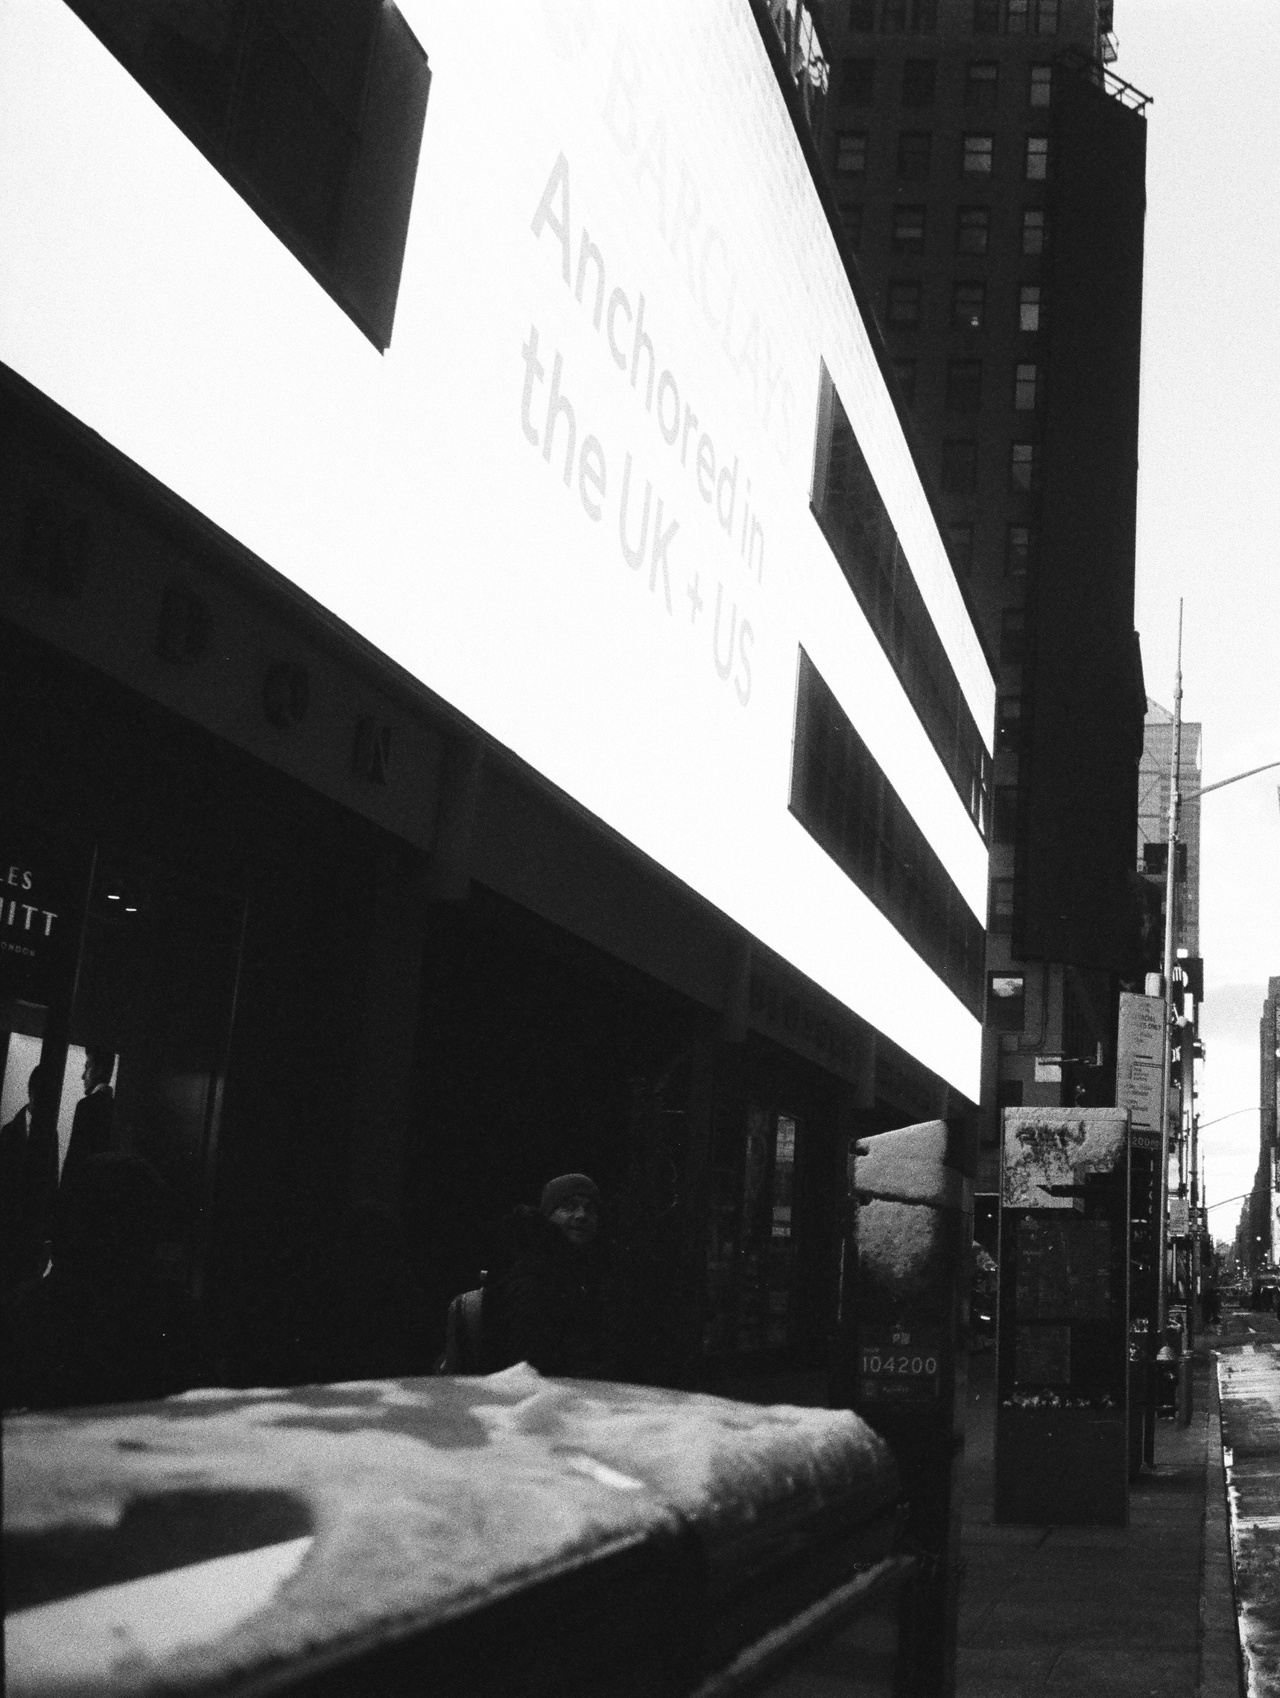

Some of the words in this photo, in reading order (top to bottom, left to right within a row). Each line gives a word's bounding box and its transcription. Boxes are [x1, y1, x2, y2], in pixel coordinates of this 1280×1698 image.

[530, 149, 739, 539] Anchored
[741, 476, 765, 585] in
[520, 323, 607, 523] the
[619, 450, 681, 617] UK
[713, 581, 755, 708] US
[0, 865, 33, 890] ES
[863, 1355, 938, 1375] 104200
